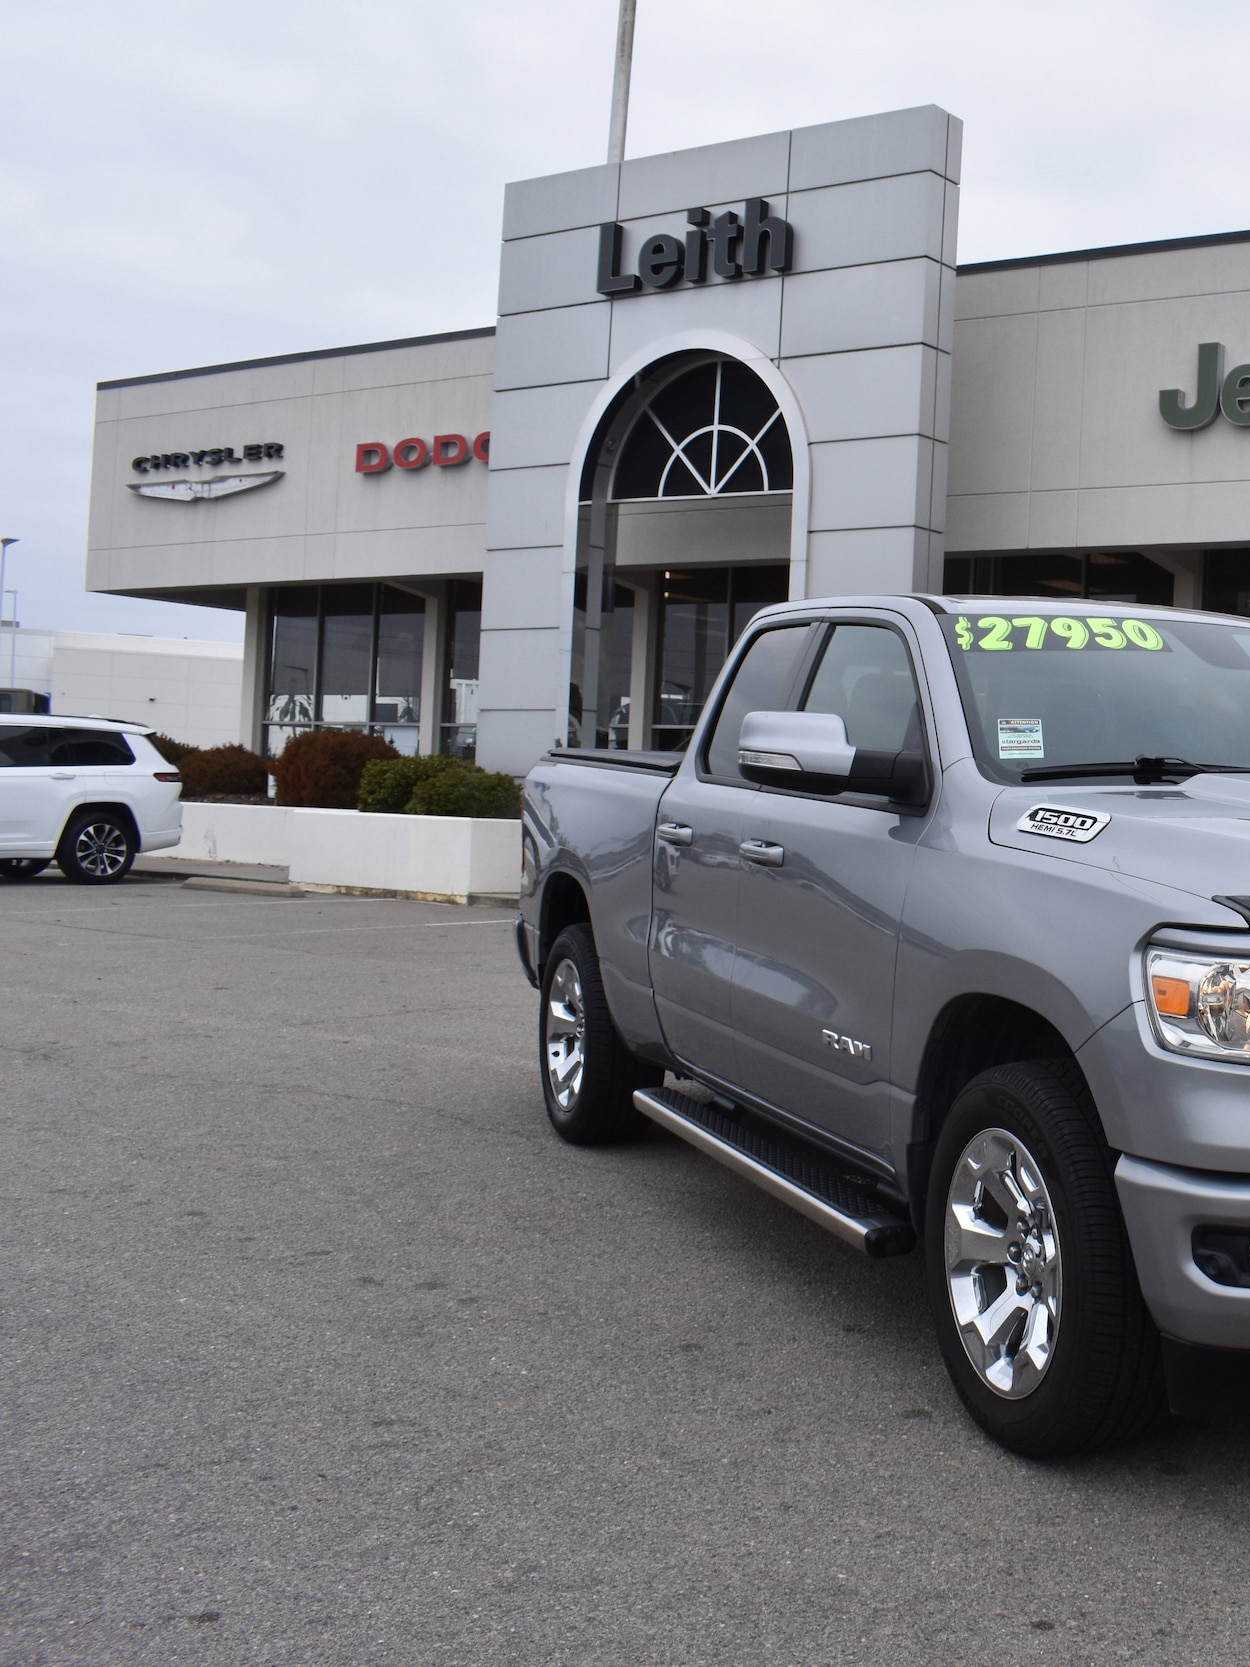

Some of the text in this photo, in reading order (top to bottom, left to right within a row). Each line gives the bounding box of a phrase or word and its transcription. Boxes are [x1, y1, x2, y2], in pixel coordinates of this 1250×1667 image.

[596, 198, 794, 295] Leith
[132, 442, 285, 473] CHRYSLER
[954, 616, 1165, 652] $27950
[1030, 822, 1079, 837] HEMI 5.7L
[1034, 809, 1095, 830] 1500
[821, 1028, 873, 1062] RAM
